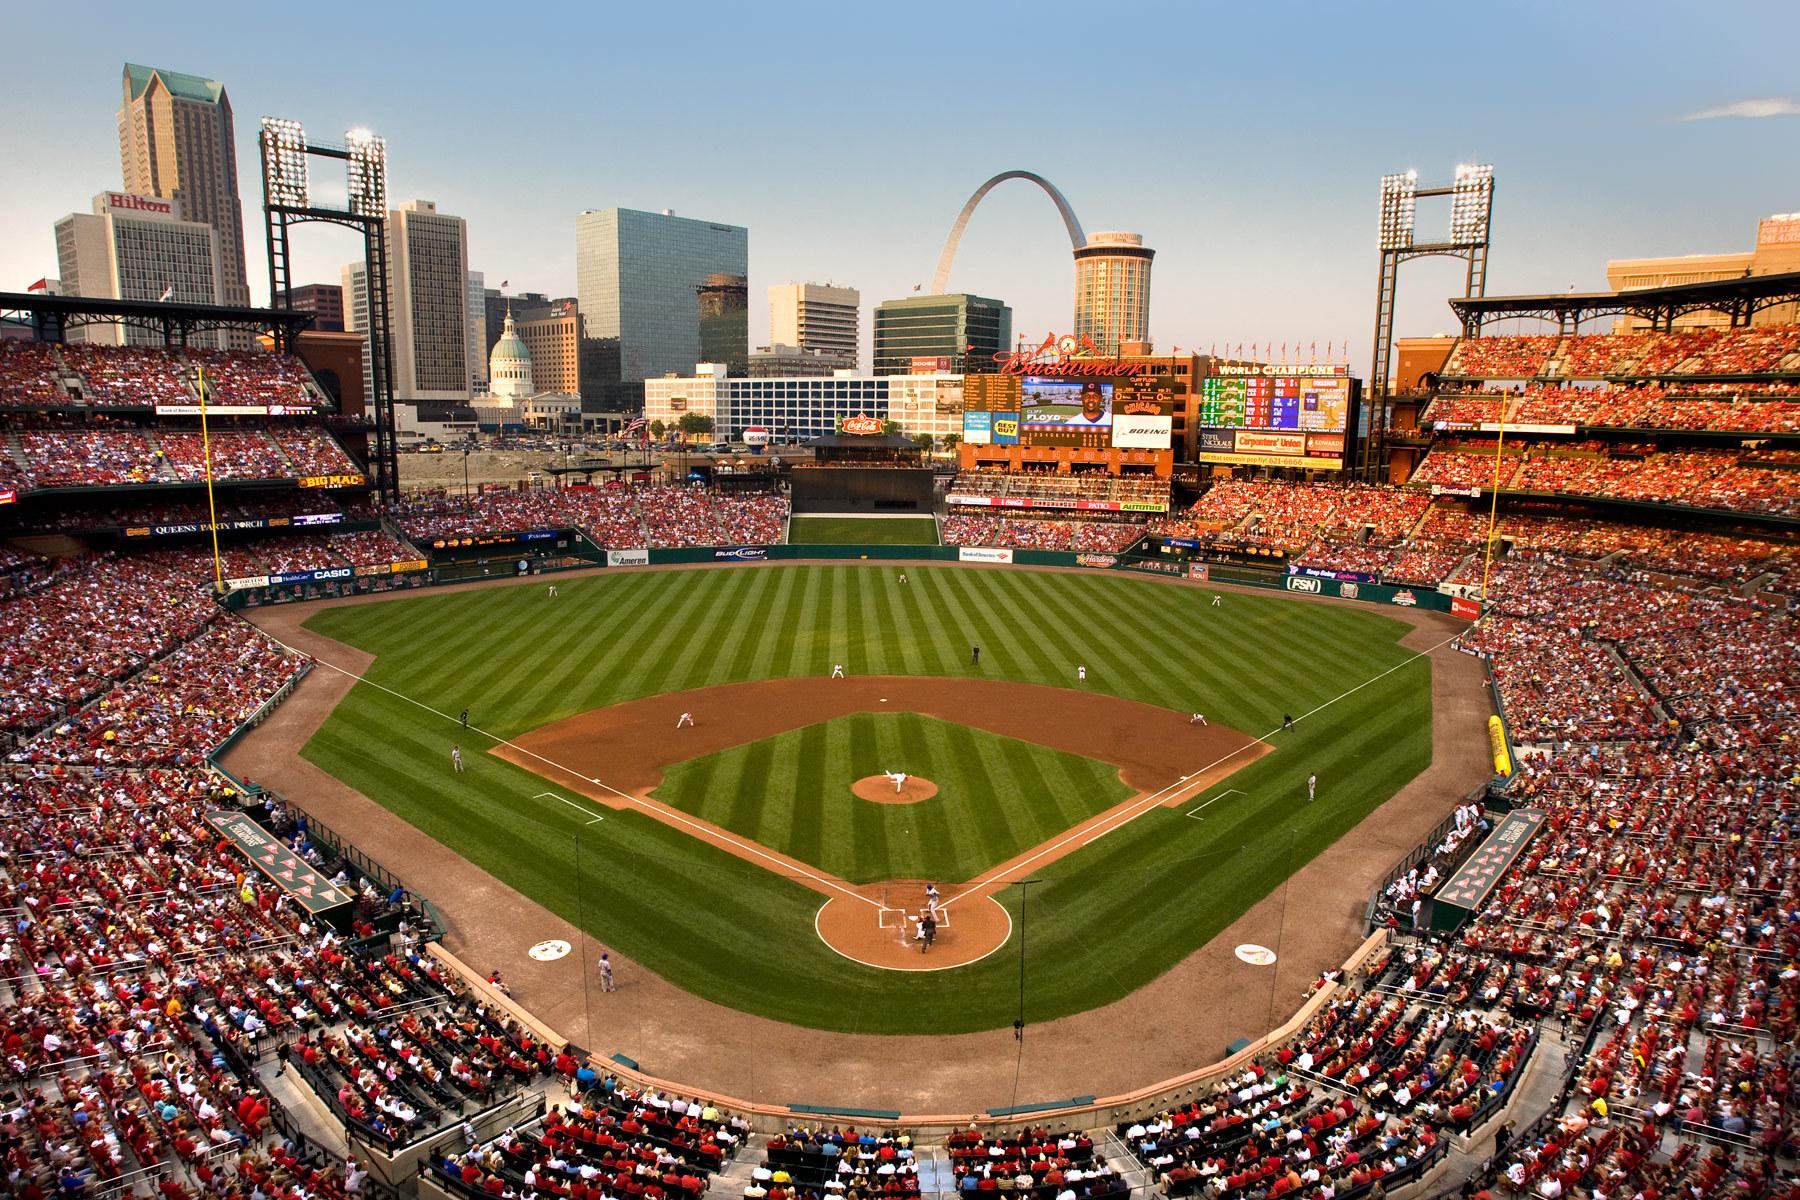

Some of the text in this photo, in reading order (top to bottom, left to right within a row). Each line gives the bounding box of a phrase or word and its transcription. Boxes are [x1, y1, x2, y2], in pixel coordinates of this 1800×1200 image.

[109, 193, 171, 214] Hilton
[992, 351, 1144, 376] Budweiser
[1219, 365, 1335, 375] WORLD CHAMPIONS
[1203, 439, 1233, 447] NICOLAUS
[1239, 437, 1302, 448] Carpenters' Union
[306, 475, 359, 487] BIG MAC
[155, 524, 197, 535] QUEEN'S
[200, 522, 231, 532] PARTY
[234, 519, 264, 530] PORCH
[619, 557, 647, 565] Ameren
[314, 568, 351, 580] CASIO
[1291, 579, 1316, 592] FSN
